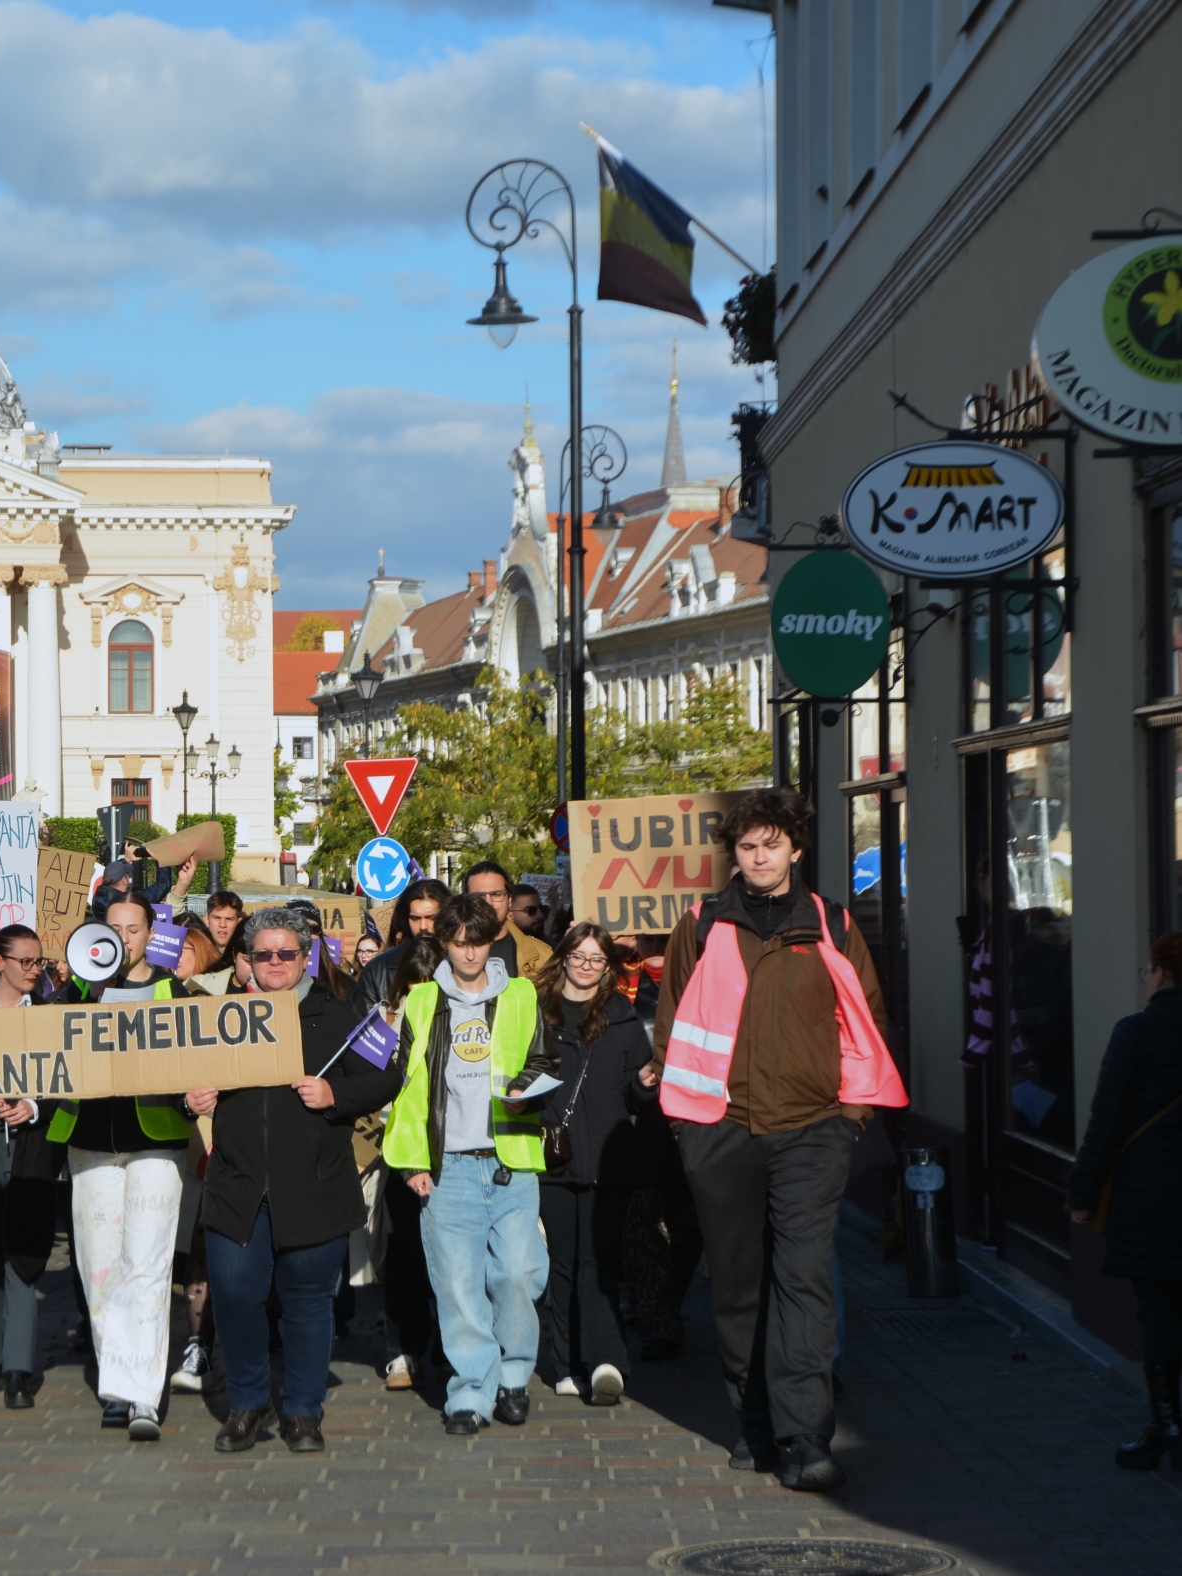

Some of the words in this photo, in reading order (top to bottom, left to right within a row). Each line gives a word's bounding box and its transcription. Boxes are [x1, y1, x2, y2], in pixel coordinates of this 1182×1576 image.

[1112, 250, 1182, 300] HYPER
[1047, 348, 1172, 434] MAGAZIN
[878, 538, 921, 562] MAGAZIN
[924, 553, 981, 564] ALIMENTAR
[779, 608, 883, 642] smoky
[44, 852, 90, 888] ALL
[597, 854, 713, 891] NU
[42, 885, 88, 917] BUT
[63, 998, 278, 1052] FEMEILOR
[464, 1047, 484, 1056] CAFE
